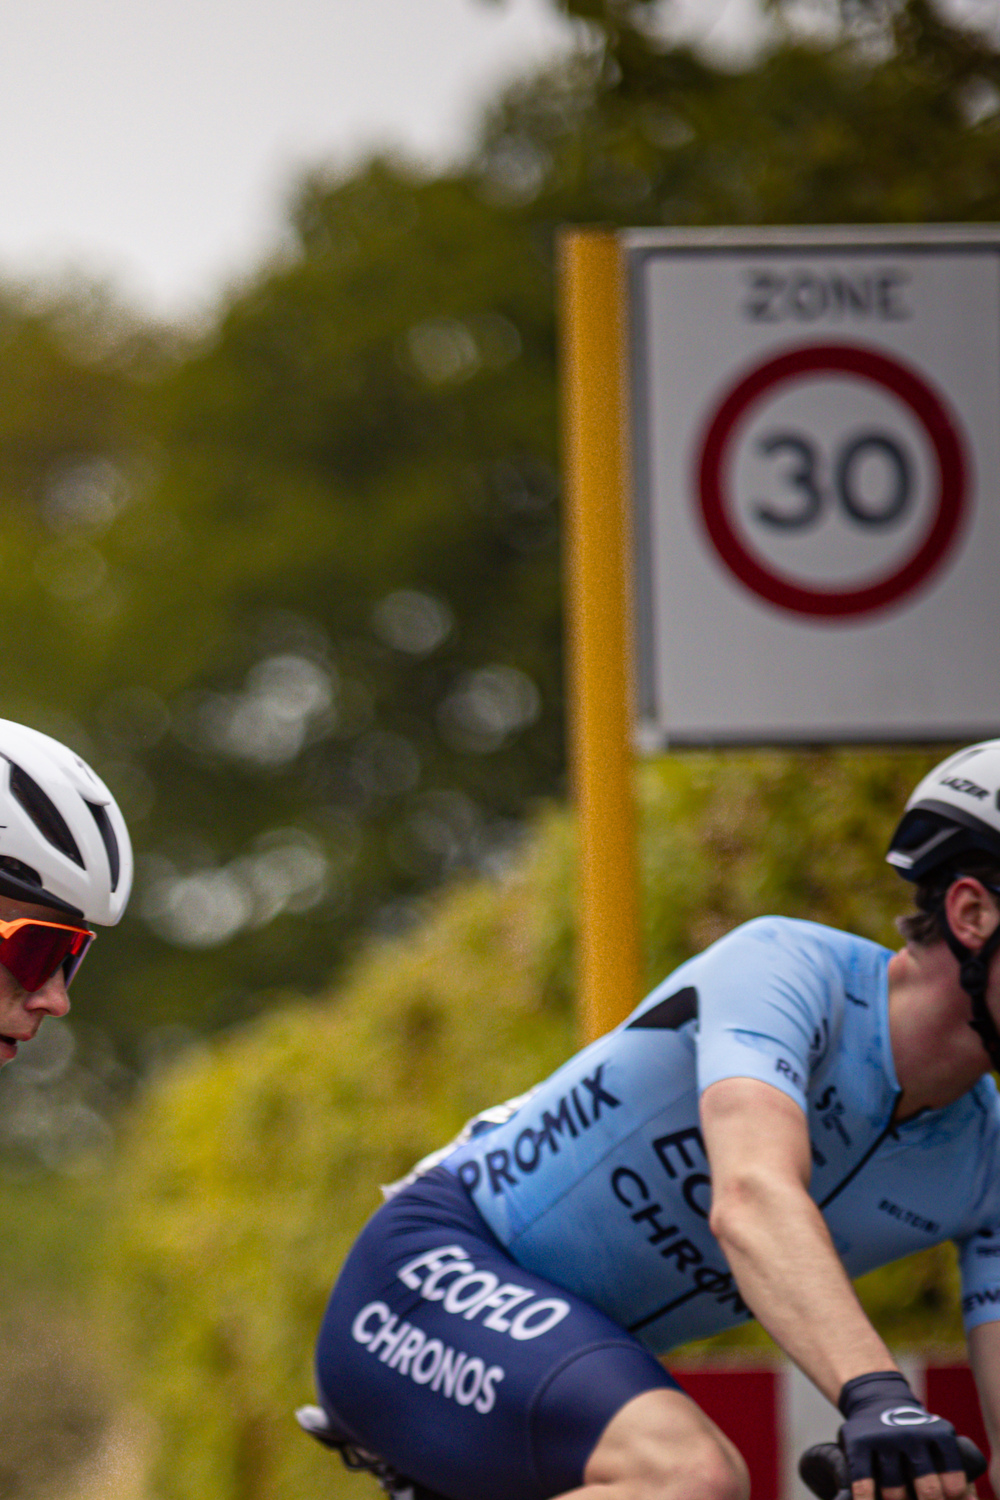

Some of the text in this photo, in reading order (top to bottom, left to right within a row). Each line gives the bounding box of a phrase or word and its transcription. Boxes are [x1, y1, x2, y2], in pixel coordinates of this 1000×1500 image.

[744, 266, 914, 324] ZONE
[754, 428, 918, 532] 30
[397, 1244, 572, 1341] ECOFLO
[352, 1301, 505, 1415] CHRONOS
